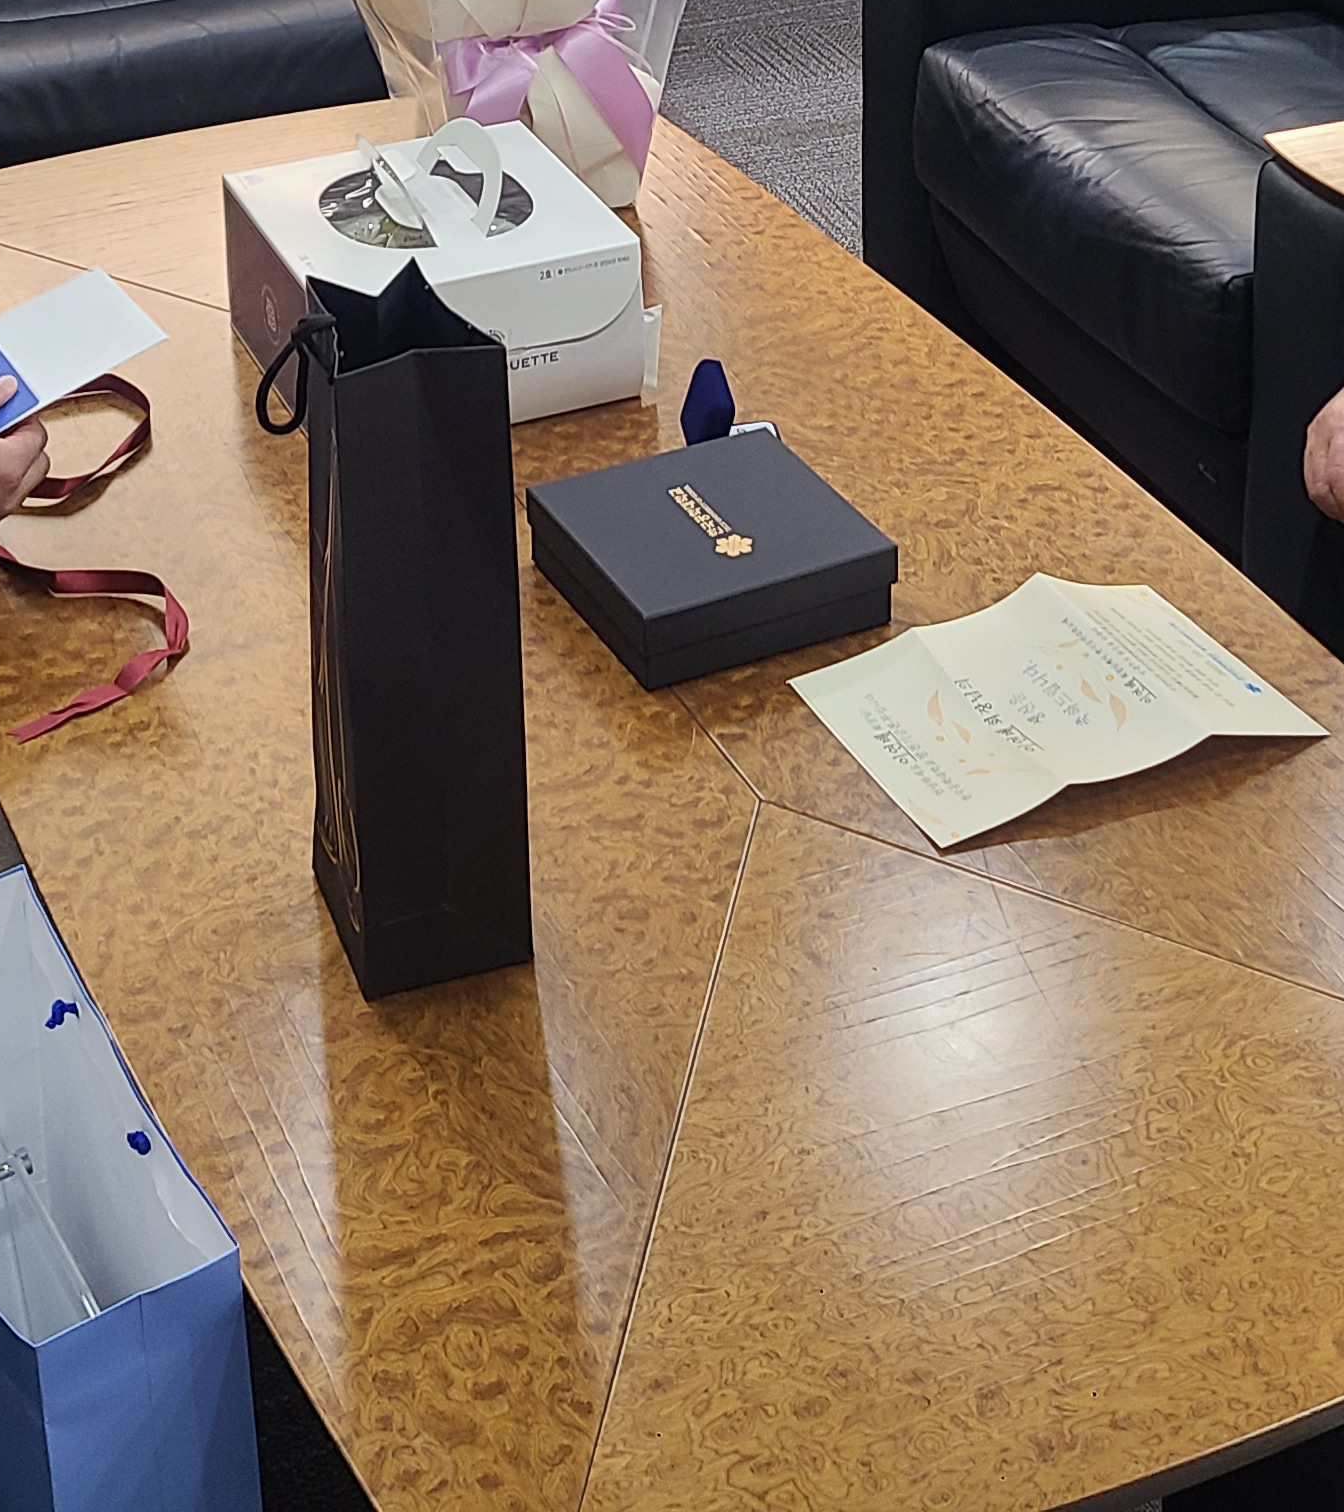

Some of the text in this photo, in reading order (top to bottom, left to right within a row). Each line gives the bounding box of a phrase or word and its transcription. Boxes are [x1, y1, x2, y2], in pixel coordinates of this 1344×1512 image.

[509, 350, 559, 370] UETTE
[1009, 692, 1045, 725] 생신을
[1022, 659, 1090, 727] 축하드립니다.
